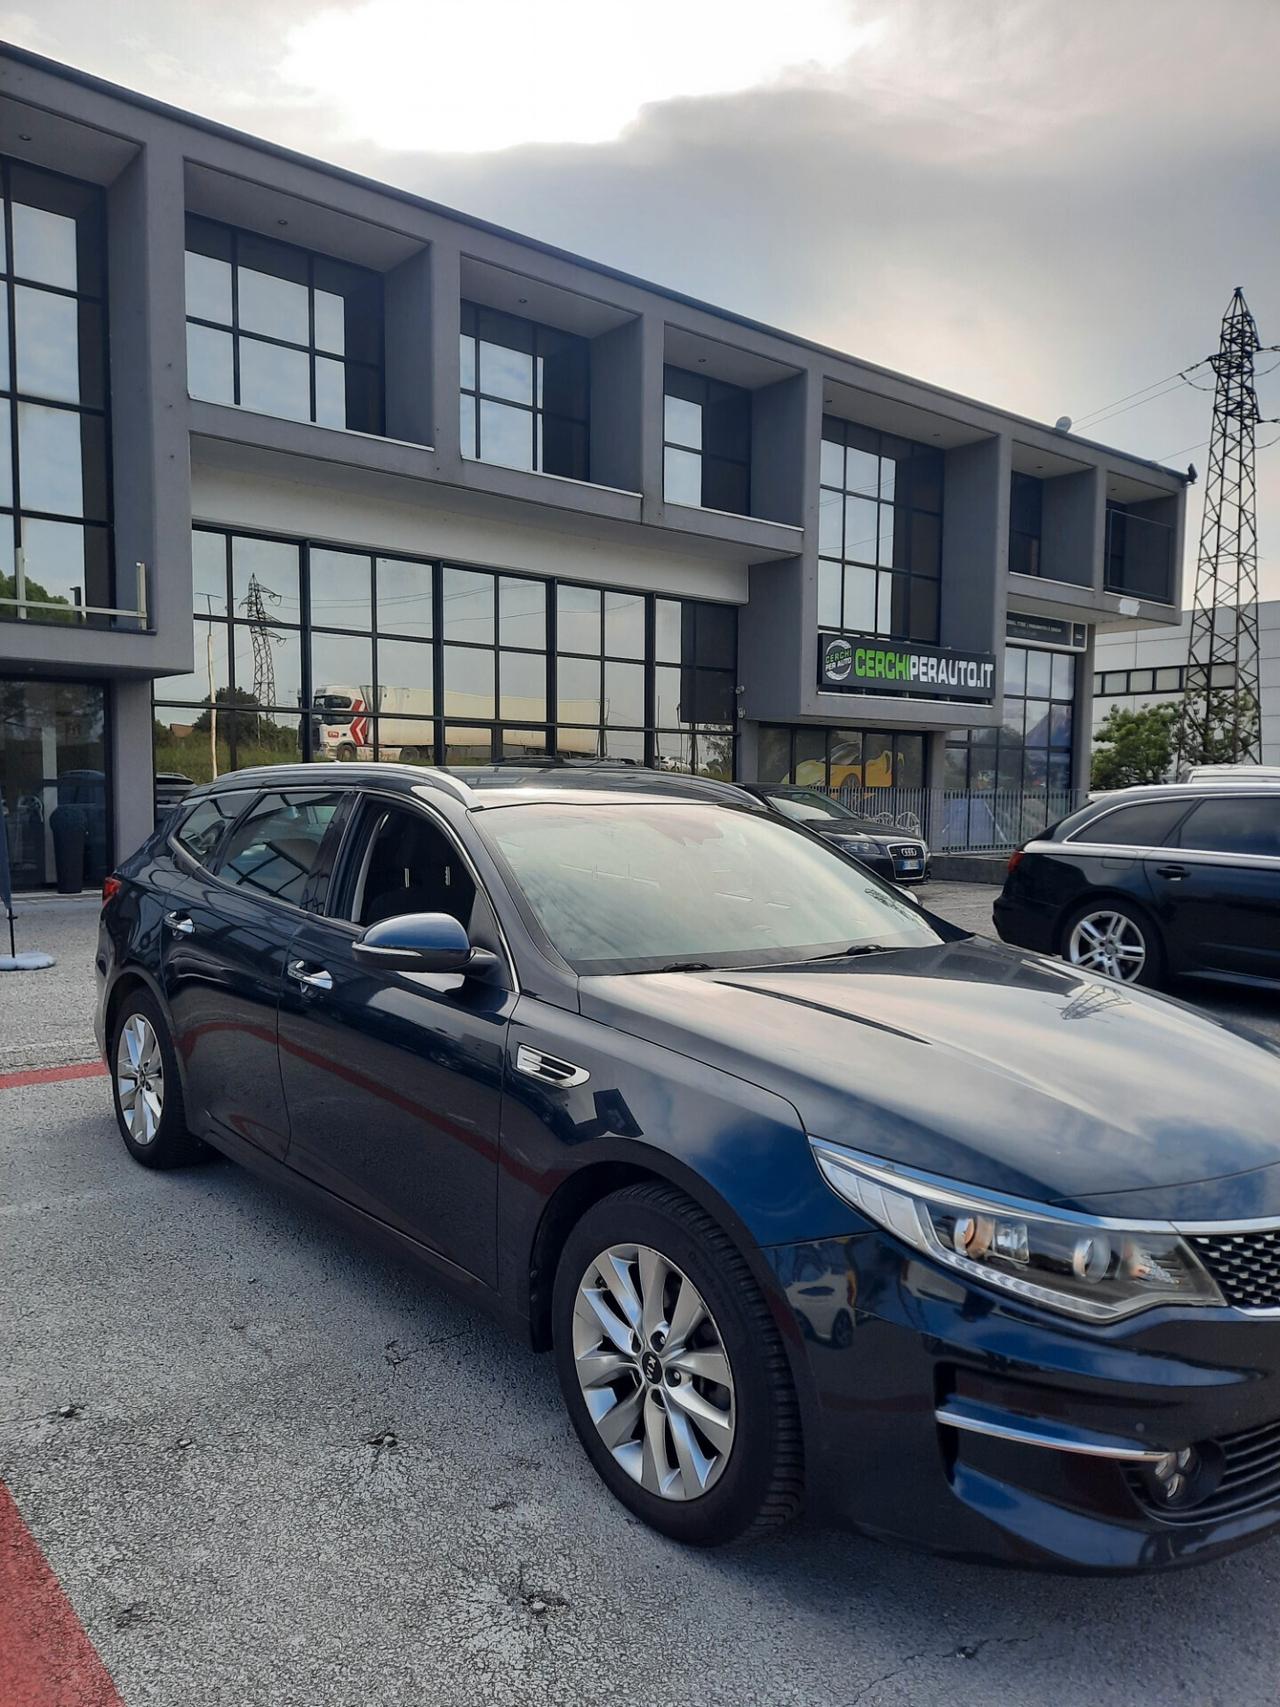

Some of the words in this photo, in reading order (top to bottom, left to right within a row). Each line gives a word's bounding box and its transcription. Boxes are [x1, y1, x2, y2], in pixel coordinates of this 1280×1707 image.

[825, 648, 852, 664] CERCHI
[855, 648, 994, 688] CERCHIPERAUTO.IT
[646, 1356, 656, 1379] KIA
